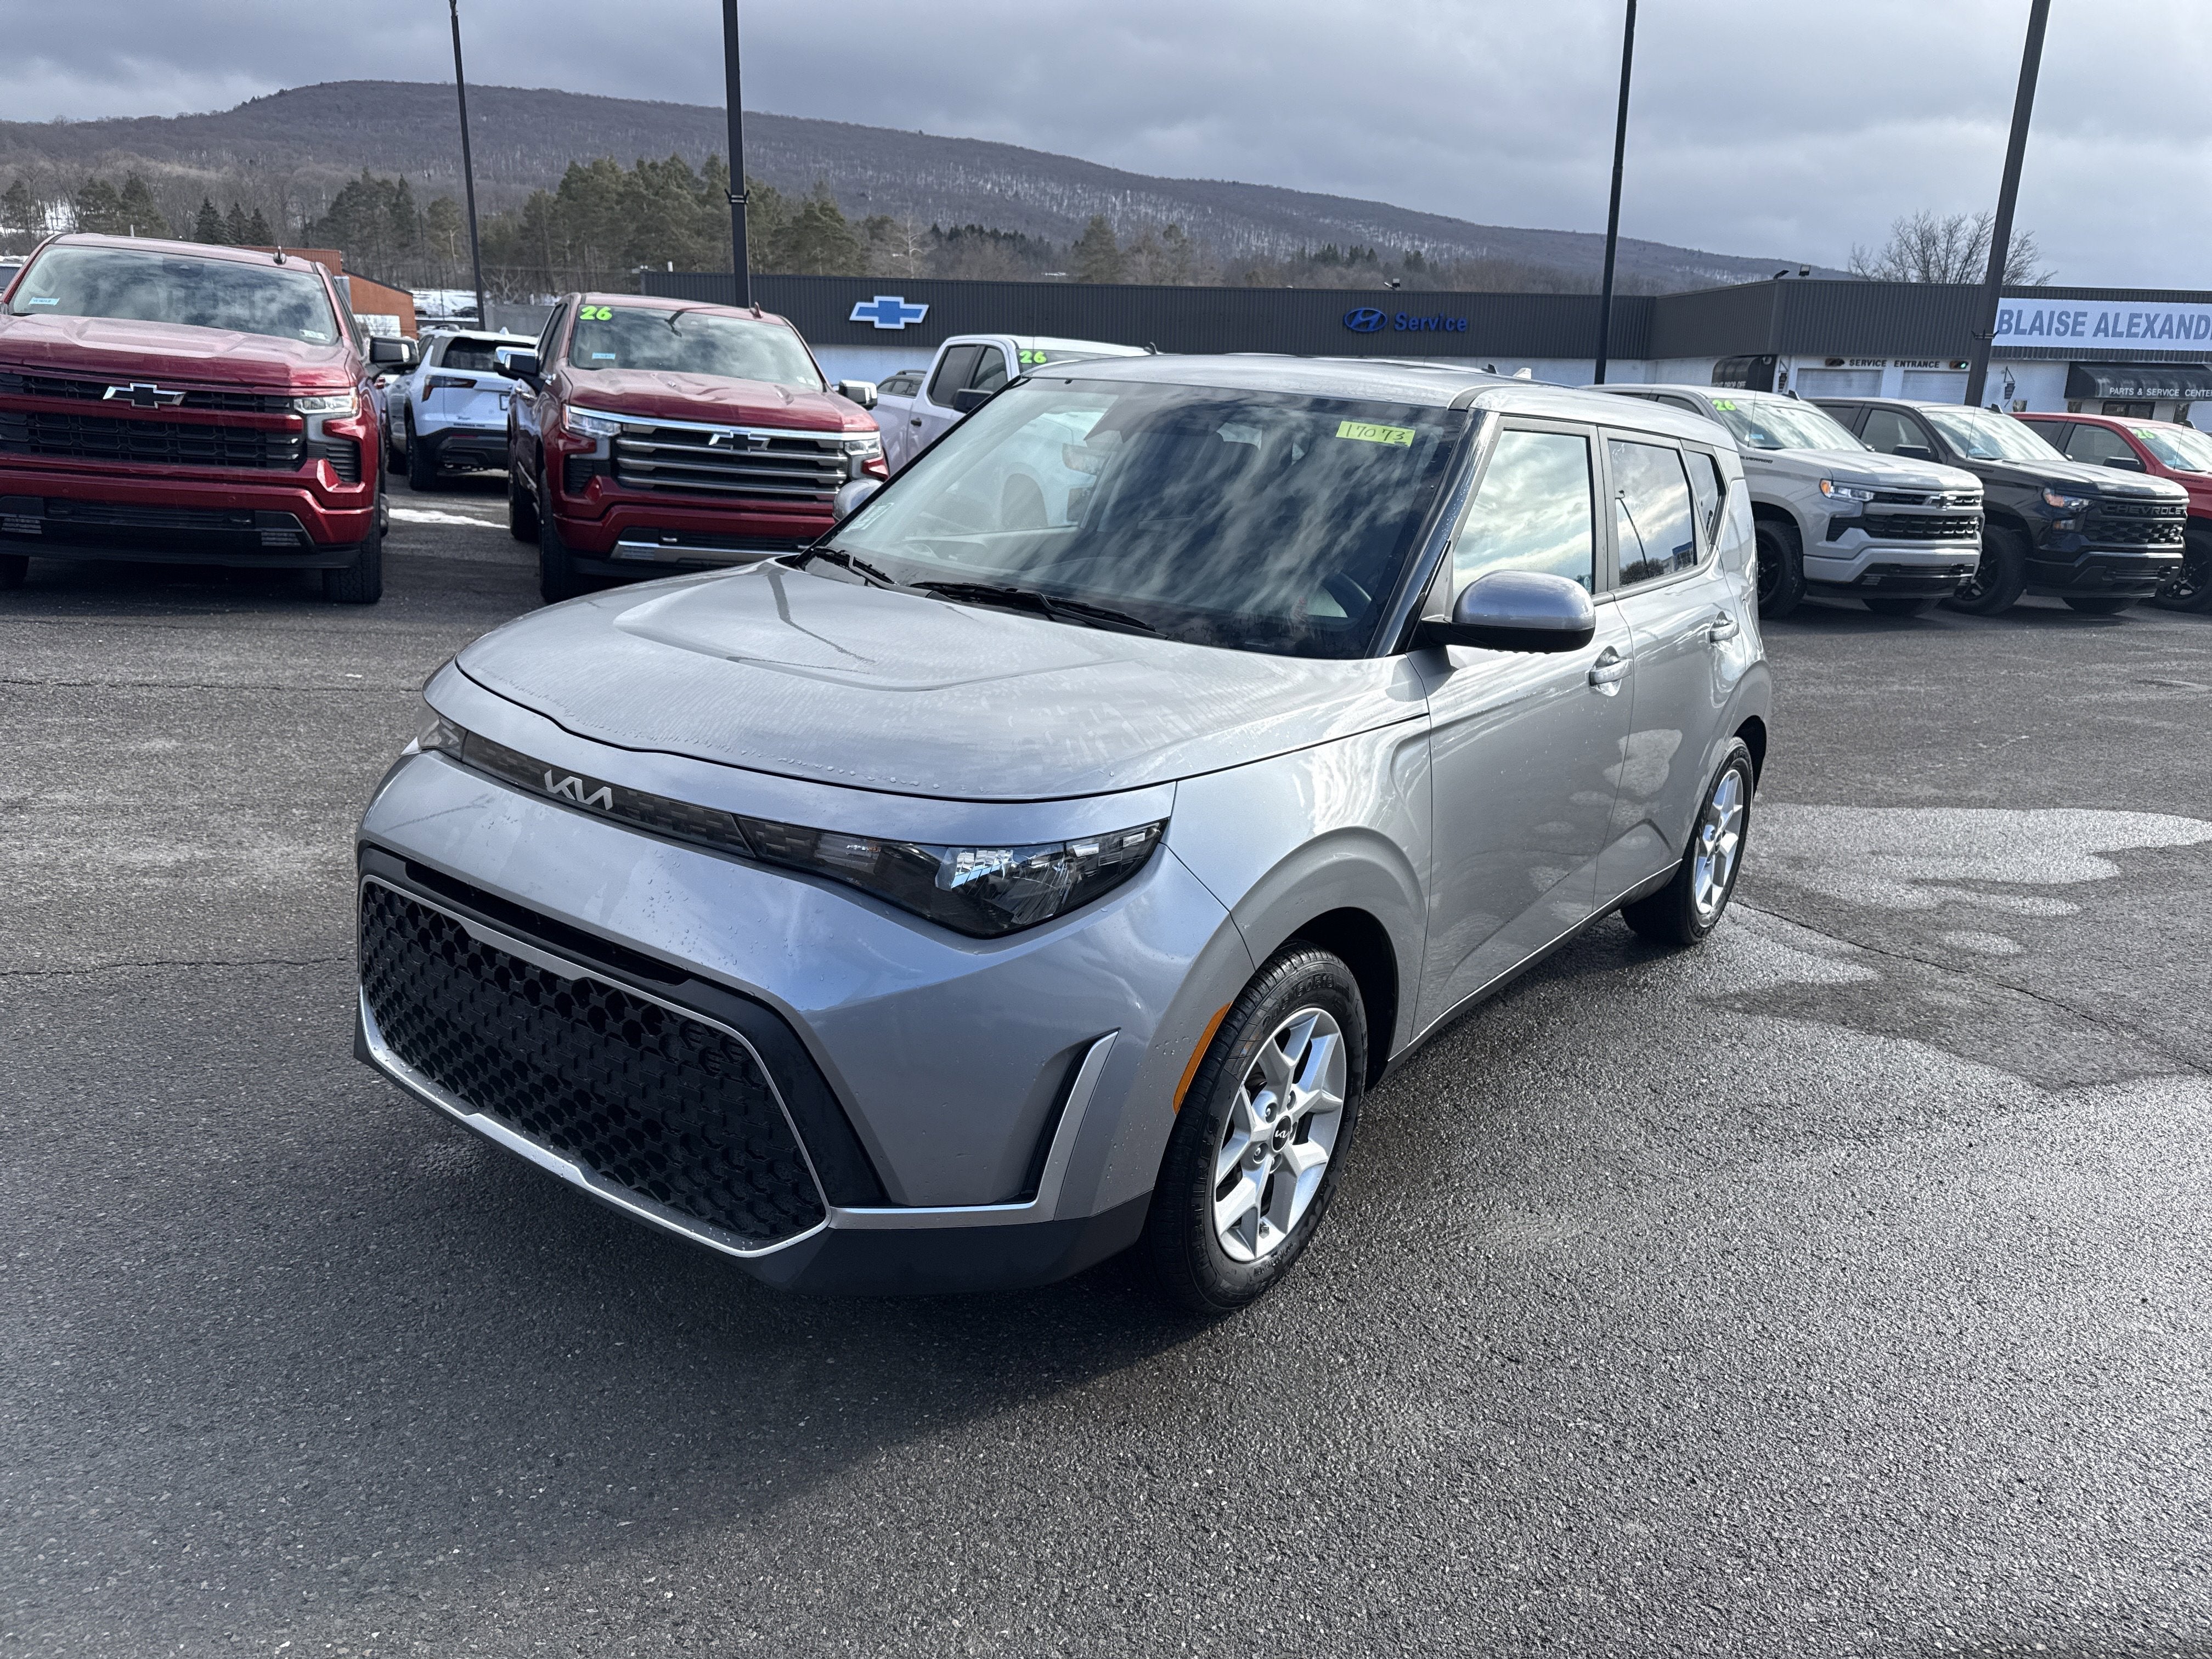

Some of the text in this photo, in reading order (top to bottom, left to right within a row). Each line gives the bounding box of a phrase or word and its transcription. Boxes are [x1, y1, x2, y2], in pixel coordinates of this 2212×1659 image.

[579, 305, 613, 321] 26
[1395, 311, 1467, 332] Service
[1997, 309, 2212, 340] BLAISE ALEXAND
[1019, 351, 1047, 364] 26
[1894, 360, 1940, 368] ENTRANCE
[2109, 387, 2134, 396] PARTS
[2146, 388, 2180, 397] SERVICE
[1712, 399, 1737, 411] 26
[2132, 429, 2154, 439] 26
[544, 769, 613, 811] KIA
